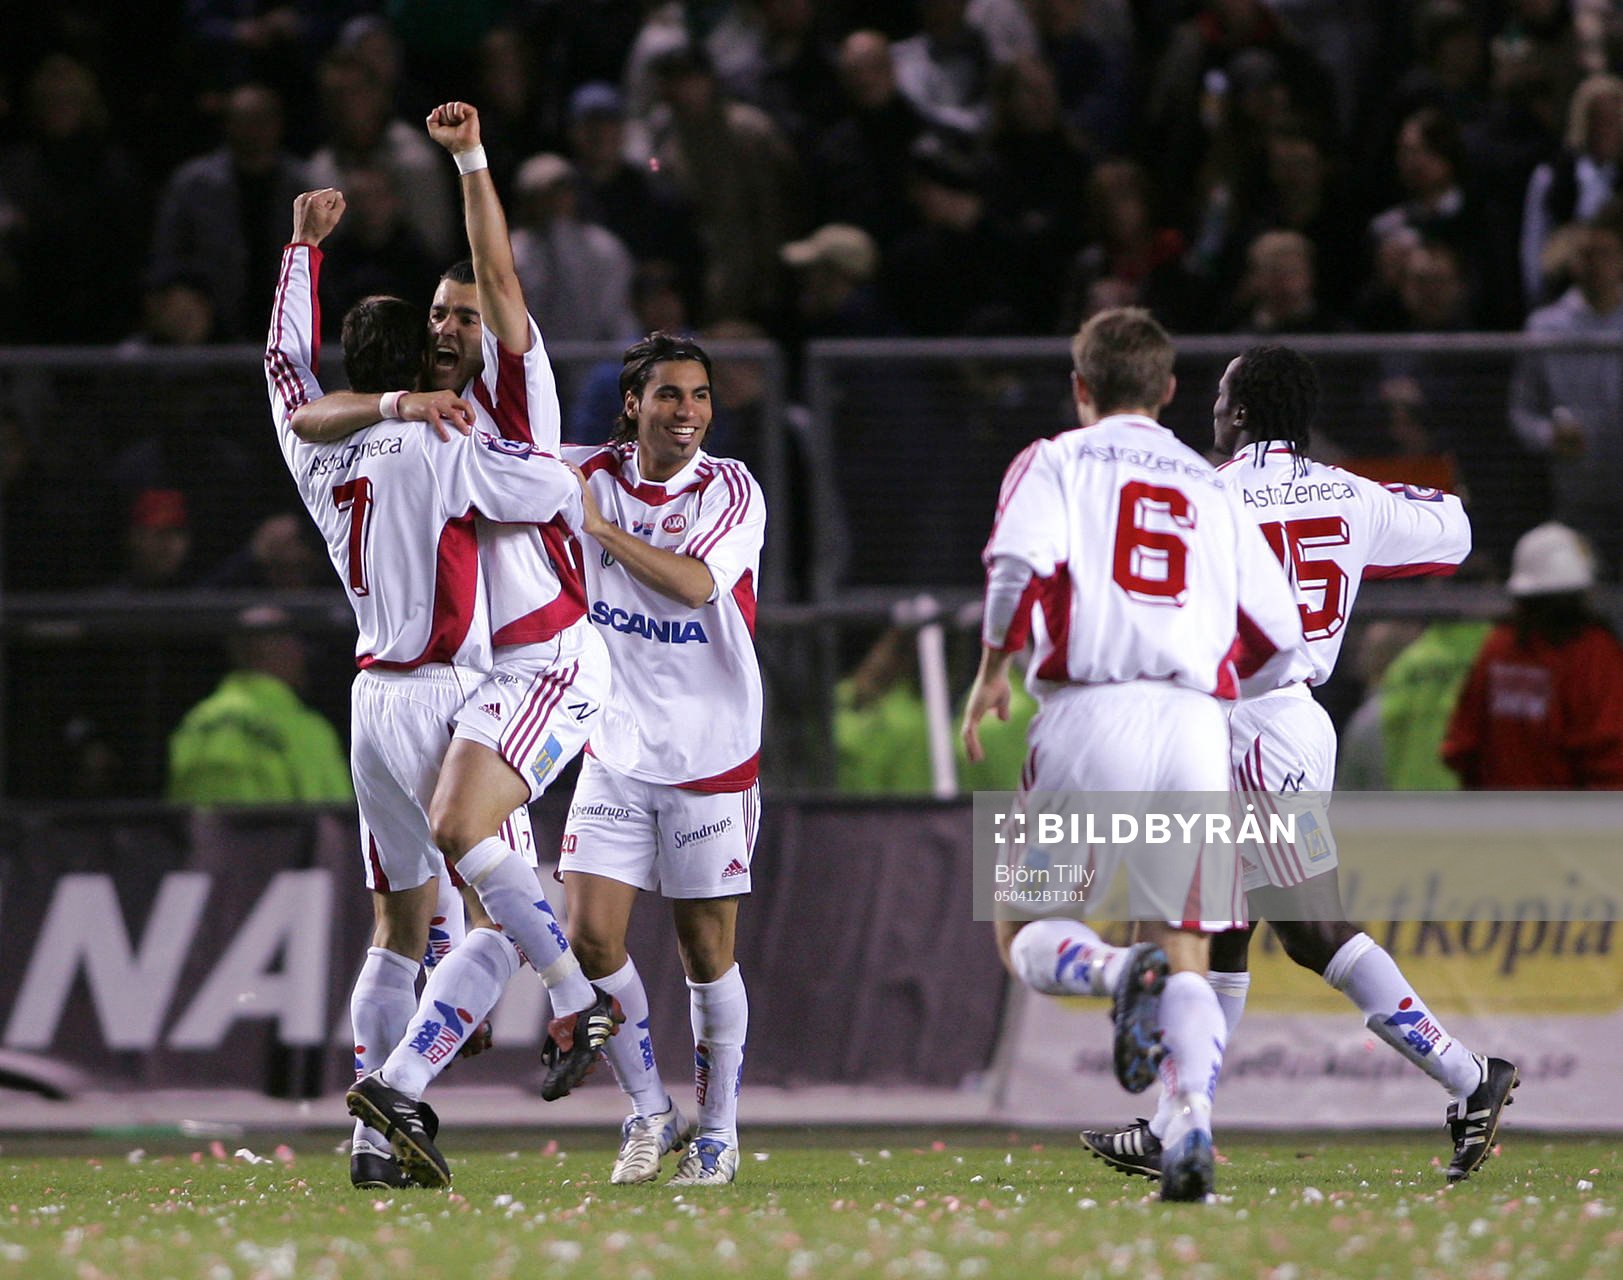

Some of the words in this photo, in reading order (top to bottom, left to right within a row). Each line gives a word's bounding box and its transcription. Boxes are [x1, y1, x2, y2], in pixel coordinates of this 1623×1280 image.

[308, 437, 402, 477] AstaZneca
[332, 476, 373, 597] 7
[664, 516, 685, 529] AXA
[1112, 480, 1196, 607] 6
[591, 600, 709, 643] SCANIA
[674, 816, 732, 849] Spendrups
[408, 1019, 441, 1054] SPORT
[422, 1025, 459, 1065] INTER
